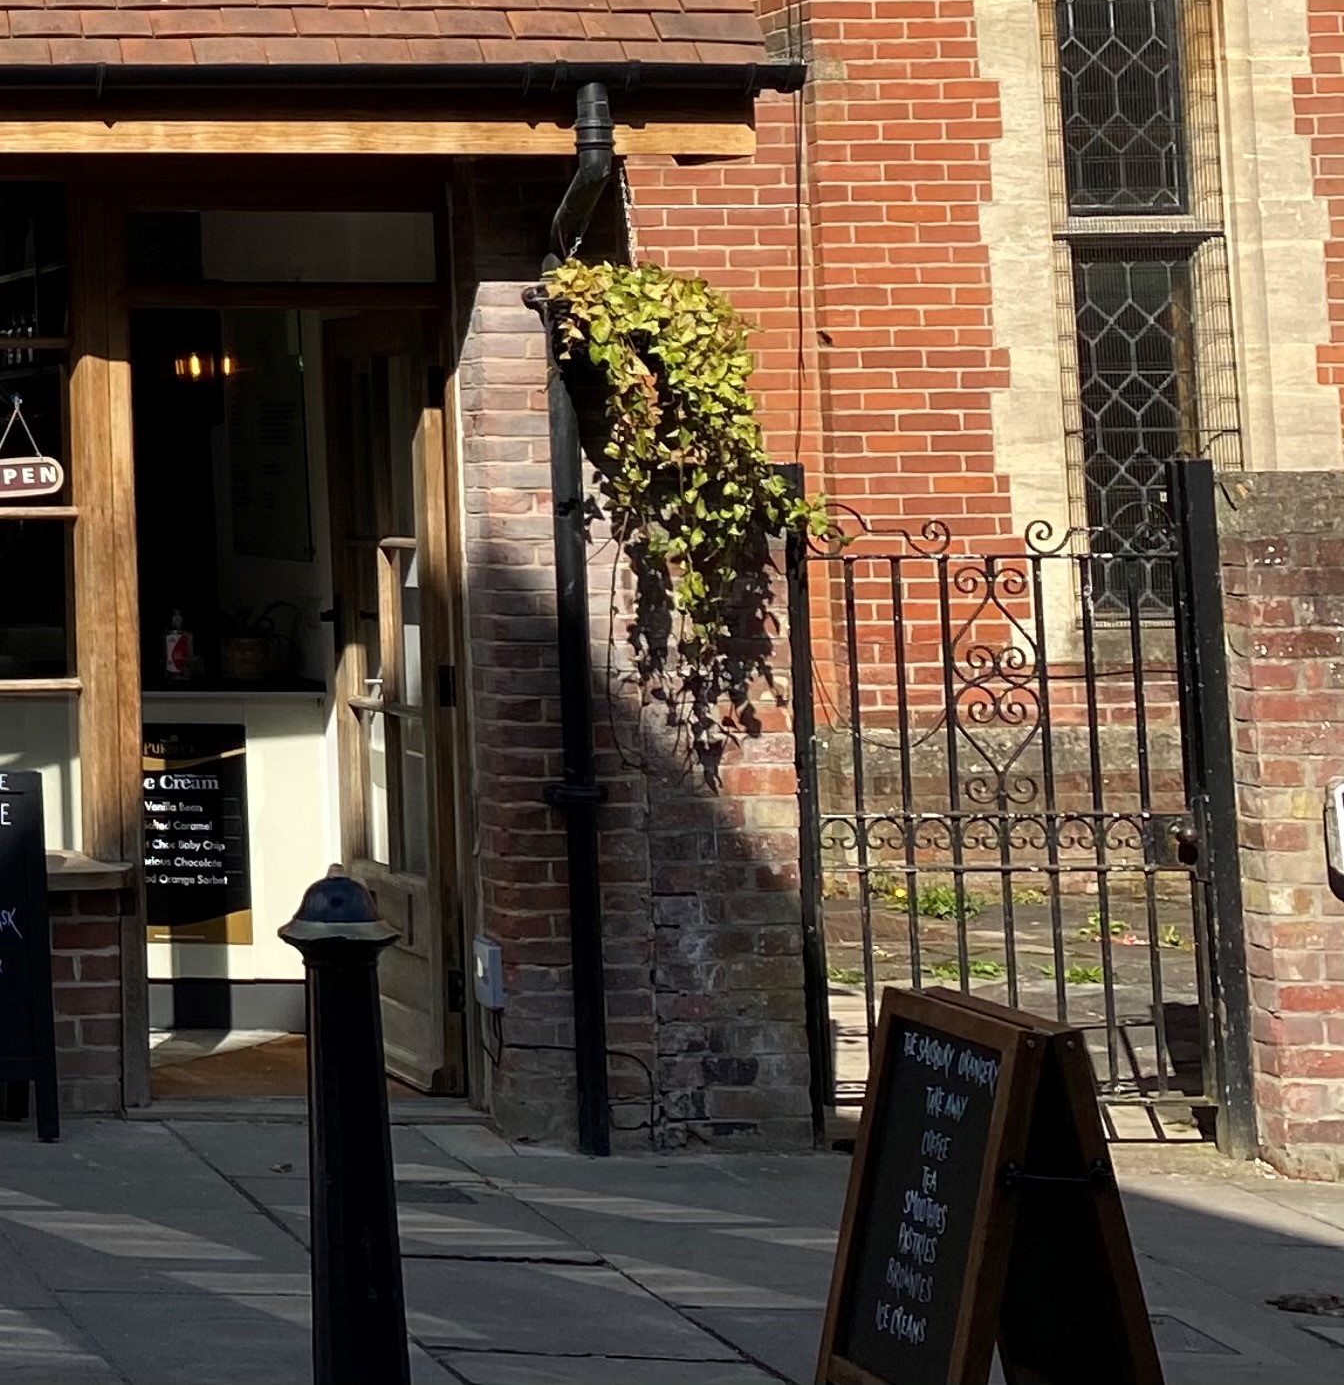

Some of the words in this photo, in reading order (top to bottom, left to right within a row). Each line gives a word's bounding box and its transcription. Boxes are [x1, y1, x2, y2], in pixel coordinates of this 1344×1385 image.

[159, 774, 219, 790] Cream
[144, 800, 177, 812] Vanilla
[173, 820, 213, 830] Caramel
[174, 856, 222, 868] Chocolate
[159, 873, 195, 886] Orange
[197, 874, 228, 885] Sorbet
[922, 1166, 937, 1194] TEA
